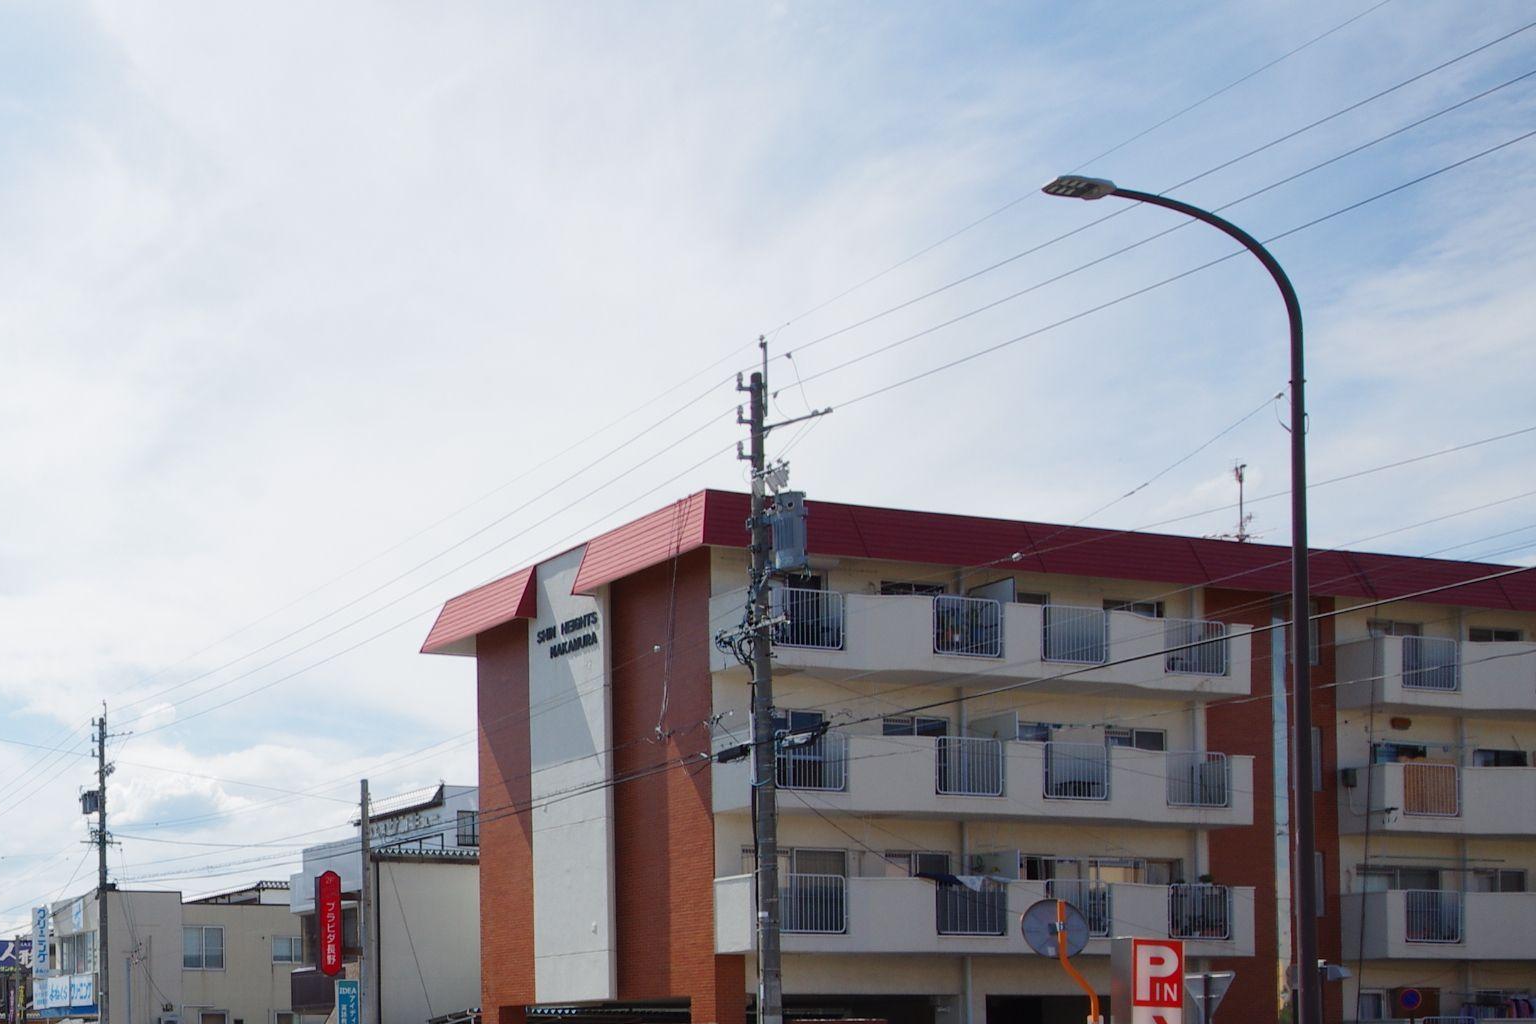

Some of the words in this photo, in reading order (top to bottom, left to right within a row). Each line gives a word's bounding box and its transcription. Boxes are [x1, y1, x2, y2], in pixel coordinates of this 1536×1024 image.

[537, 625, 556, 645] SHIN
[561, 611, 598, 635] HEIGHTS
[550, 631, 598, 659] NAKAMURA
[1137, 944, 1179, 1001] P
[339, 986, 357, 995] IDEA
[1156, 983, 1177, 1001] IN
